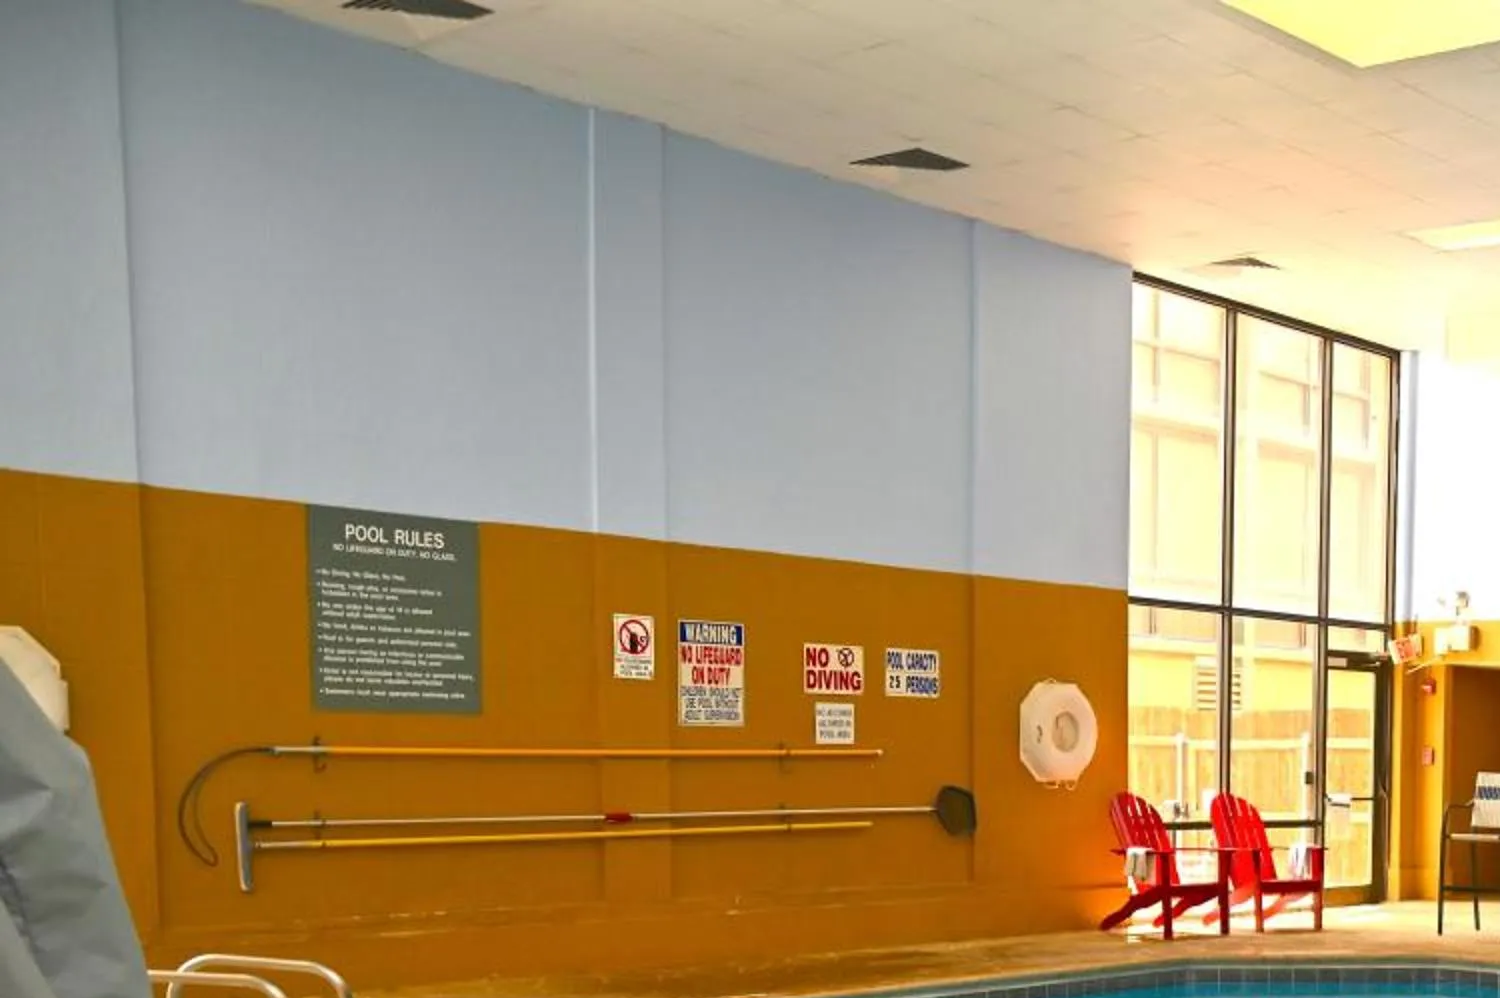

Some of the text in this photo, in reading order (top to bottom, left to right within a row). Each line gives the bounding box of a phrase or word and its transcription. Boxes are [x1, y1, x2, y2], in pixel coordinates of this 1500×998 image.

[345, 523, 444, 549] POOL RULES
[684, 623, 737, 644] WARNING
[681, 645, 742, 666] NO LIFEGUARD
[805, 647, 830, 668] NO
[887, 651, 938, 672] POOL CAPACITY
[692, 667, 730, 685] ON DUTY
[805, 669, 862, 691] DIVING
[906, 676, 939, 696] PERSONS
